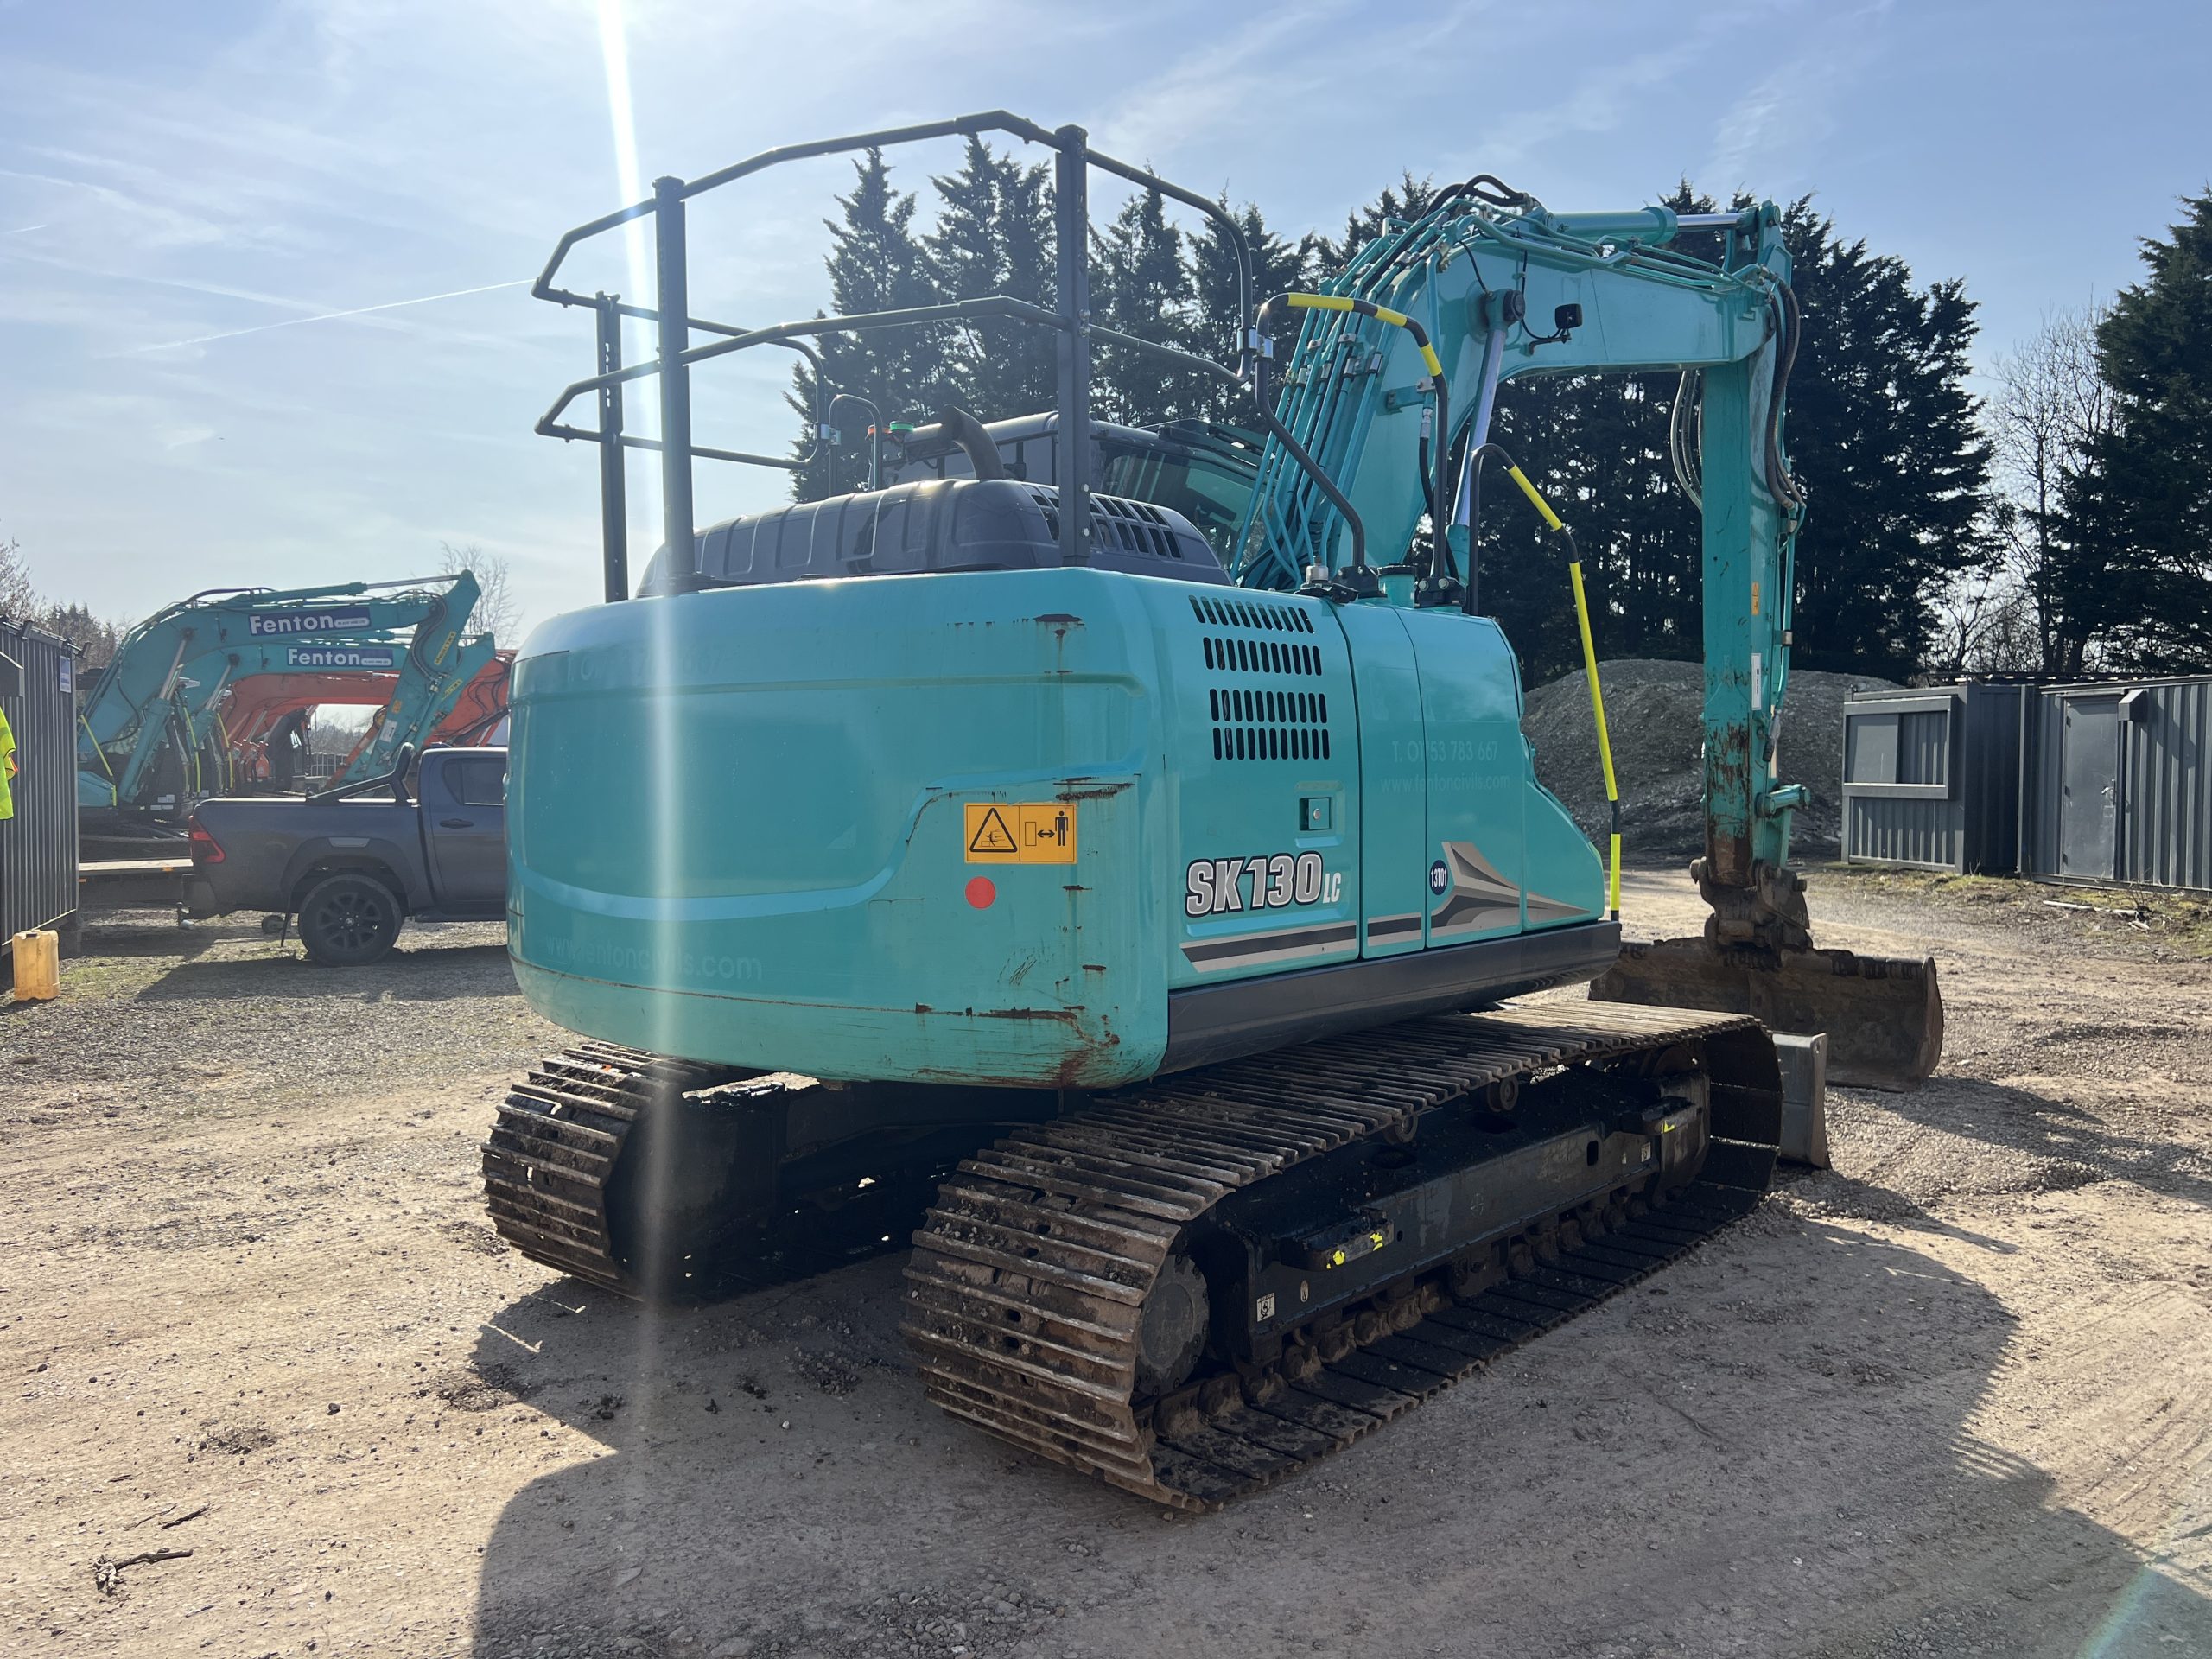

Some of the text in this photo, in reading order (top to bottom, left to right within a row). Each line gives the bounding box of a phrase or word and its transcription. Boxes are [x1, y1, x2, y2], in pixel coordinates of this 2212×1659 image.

[250, 615, 334, 634] Fenton
[288, 649, 360, 665] Fenton
[1450, 740, 1473, 761] 783
[1478, 740, 1498, 761] 667
[1323, 872, 1341, 904] LC
